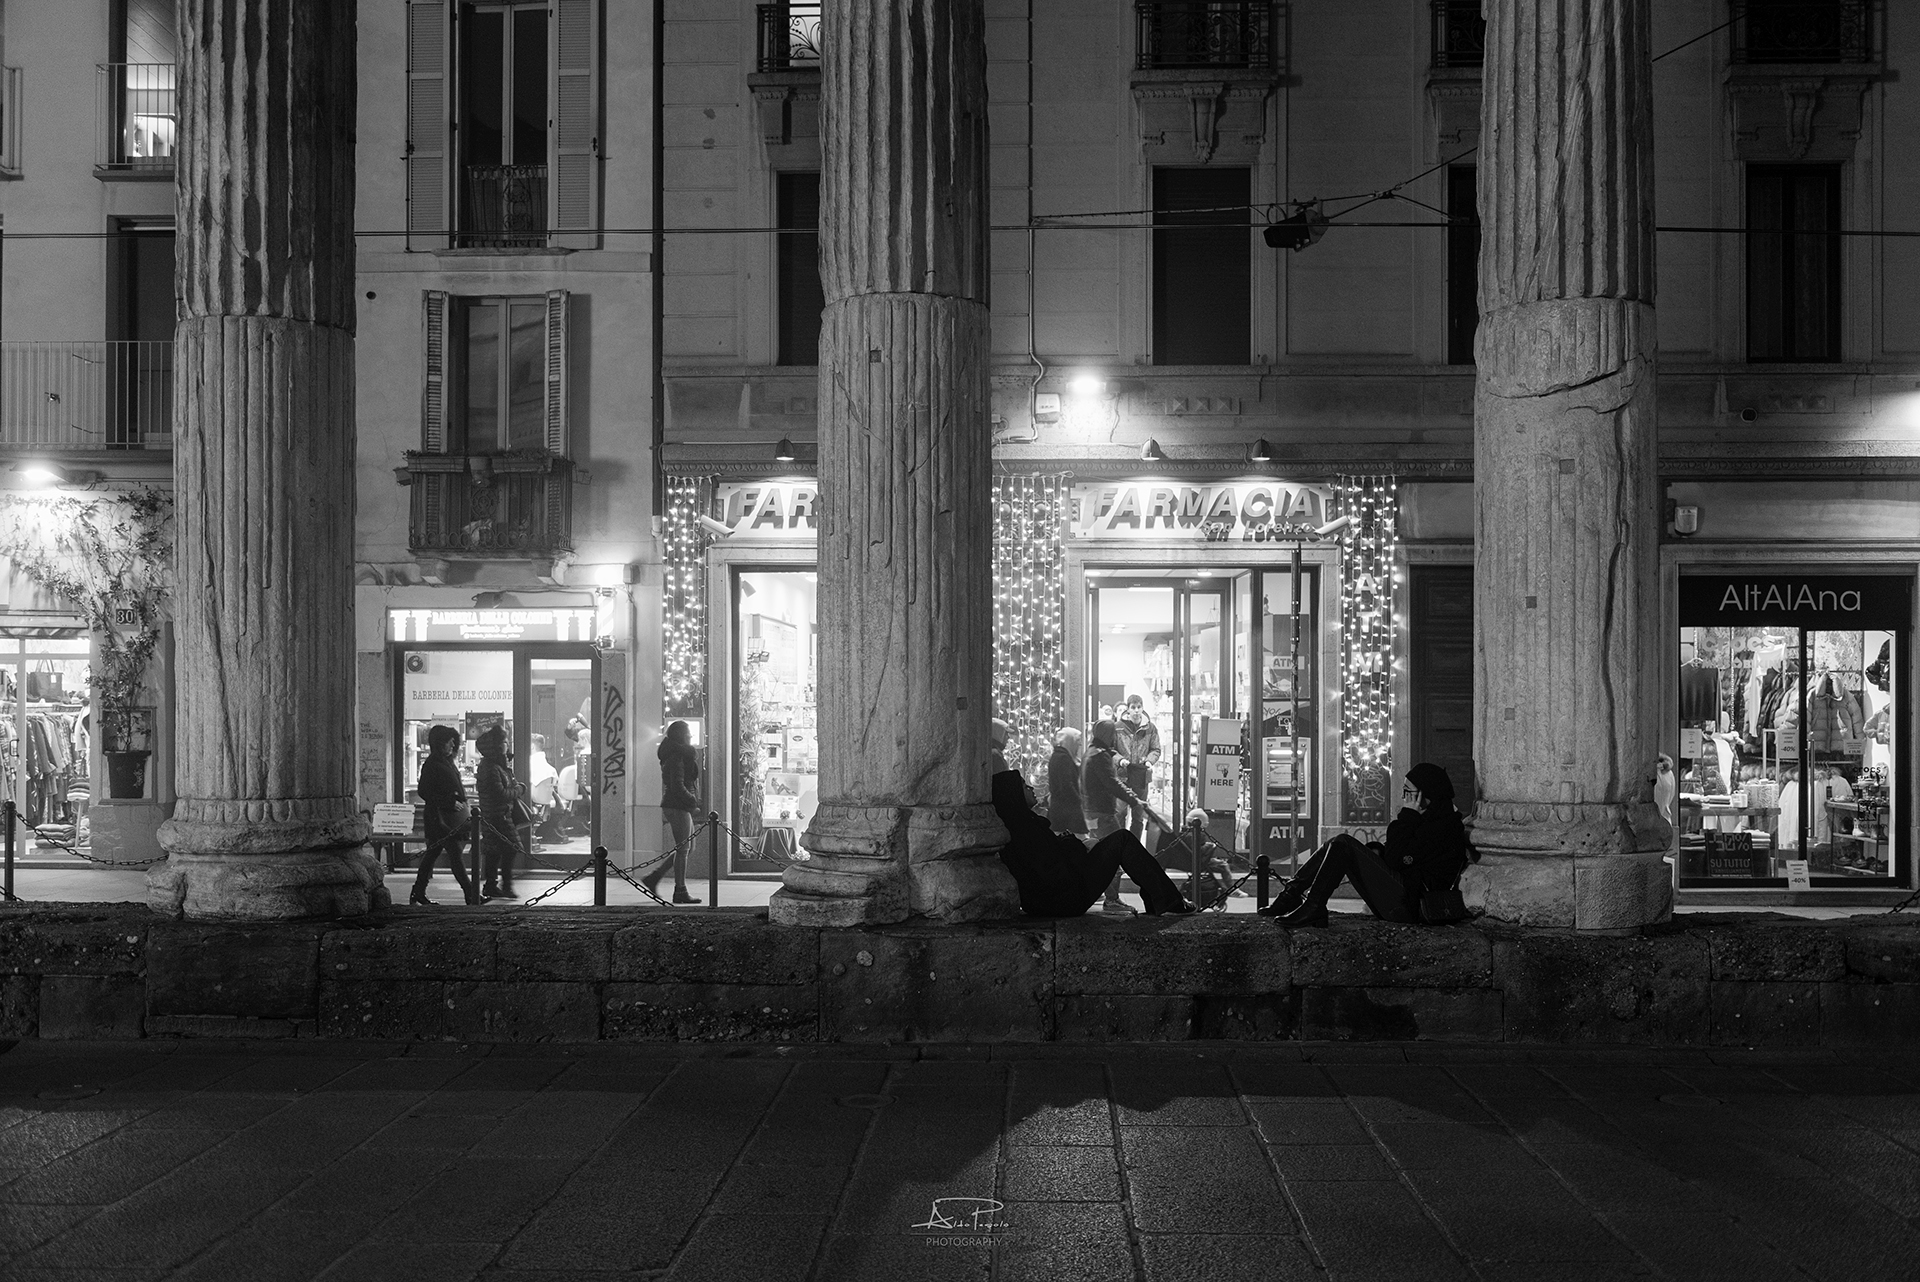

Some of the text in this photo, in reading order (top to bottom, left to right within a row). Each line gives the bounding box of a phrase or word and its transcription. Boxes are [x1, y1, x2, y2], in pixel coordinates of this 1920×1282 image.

[1093, 487, 1315, 517] FARMACIA
[1201, 520, 1314, 538] San Lorenzo
[1719, 584, 1860, 611] AltAlAna
[117, 610, 133, 623] 30
[1701, 637, 1777, 652] crocs
[412, 690, 512, 700] BARBERIA DELLE COLONNE
[1211, 745, 1236, 755] ATM
[1210, 779, 1234, 787] HERE
[1710, 858, 1750, 868] SU TUTTO
